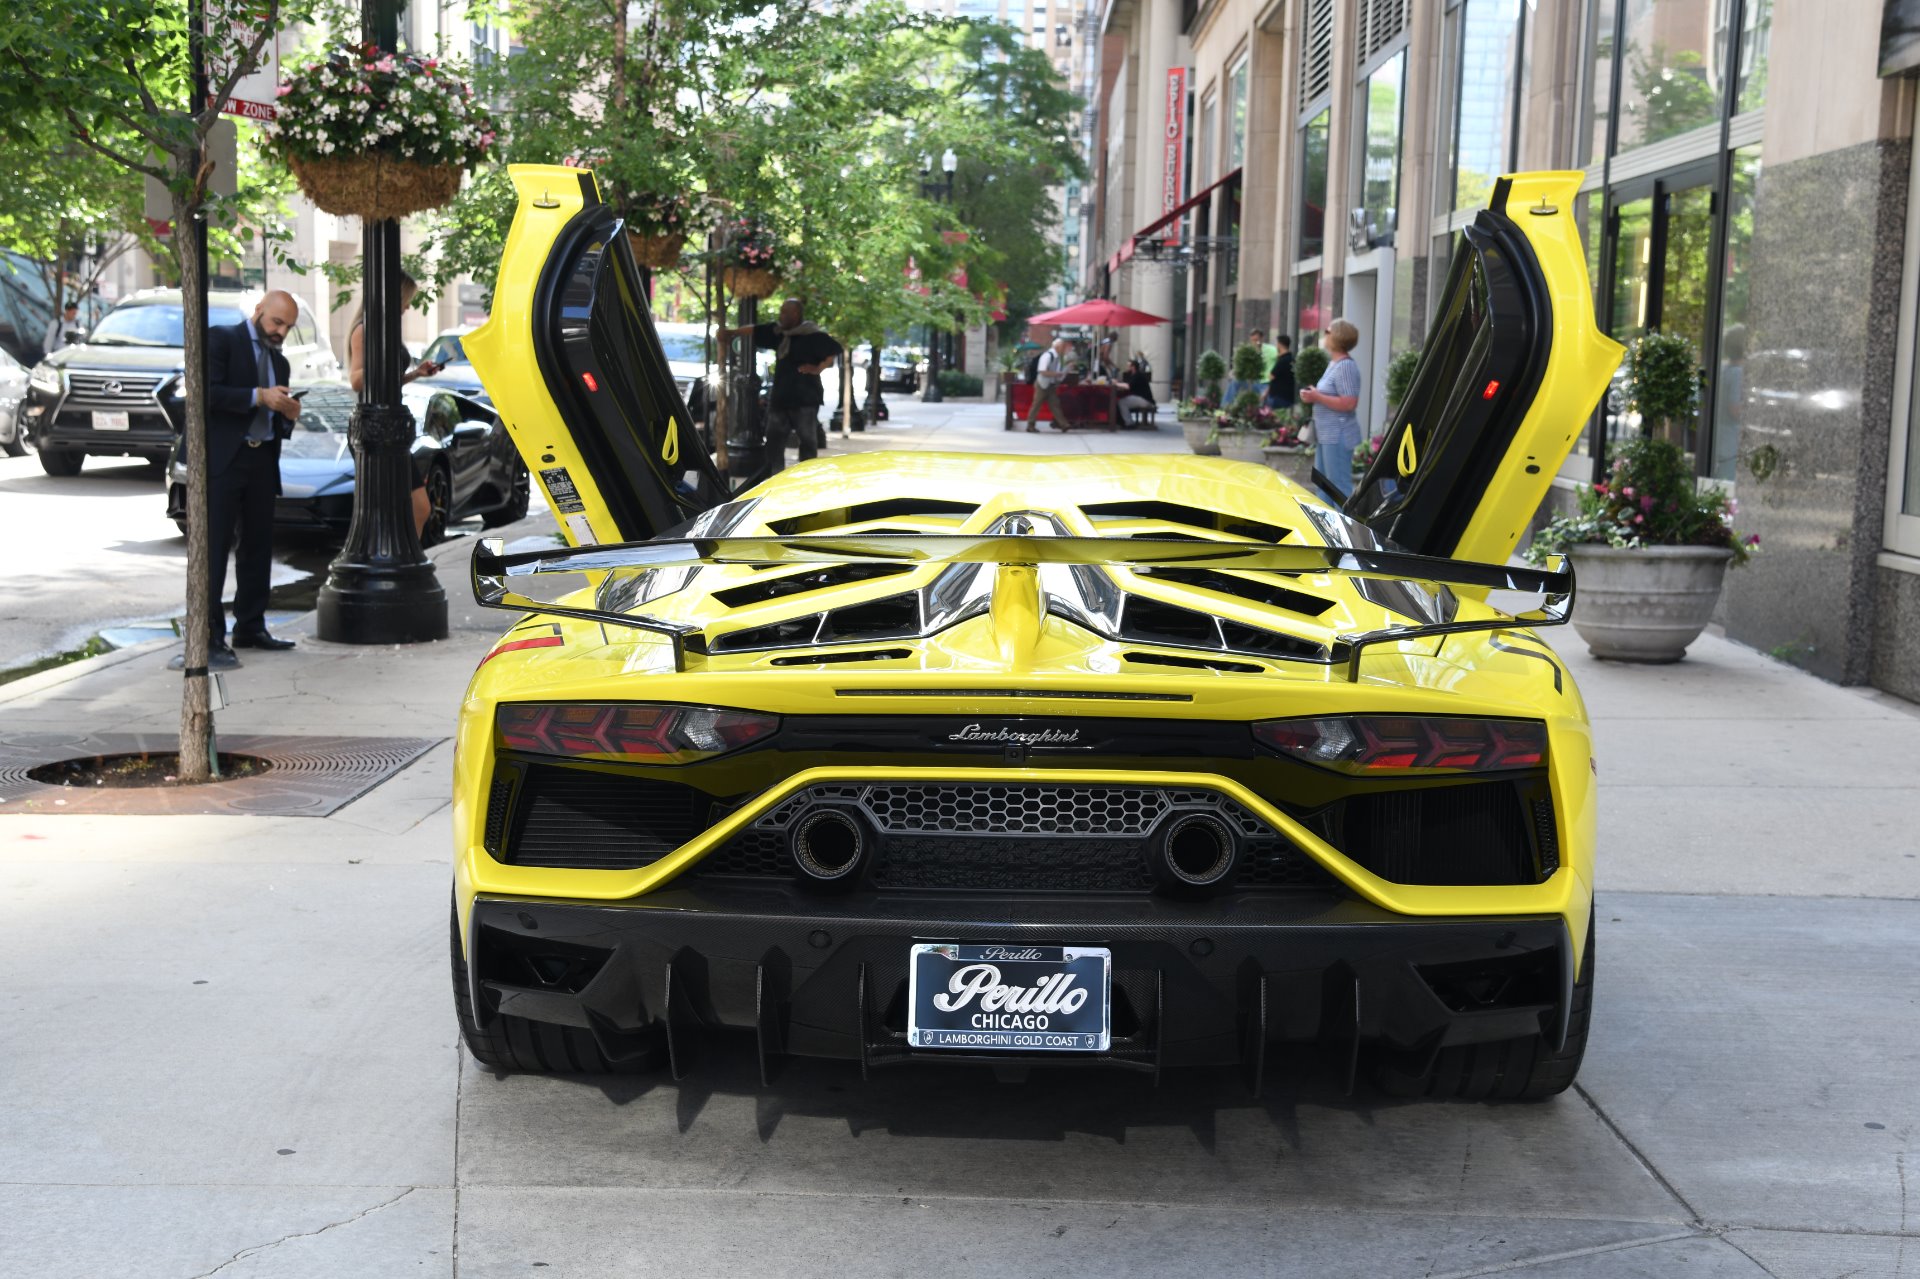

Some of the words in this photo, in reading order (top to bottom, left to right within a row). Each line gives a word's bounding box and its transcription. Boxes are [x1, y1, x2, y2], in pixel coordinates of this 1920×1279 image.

[242, 102, 273, 120] ZONE
[948, 723, 1079, 745] Lamborghini
[979, 946, 1042, 960] Perillo
[933, 964, 1088, 1015] Perillo
[971, 1013, 1049, 1030] CHICAGO
[939, 1034, 1011, 1045] LAMBORGHINI
[1014, 1035, 1043, 1046] GOLD
[1046, 1036, 1079, 1046] COAST
